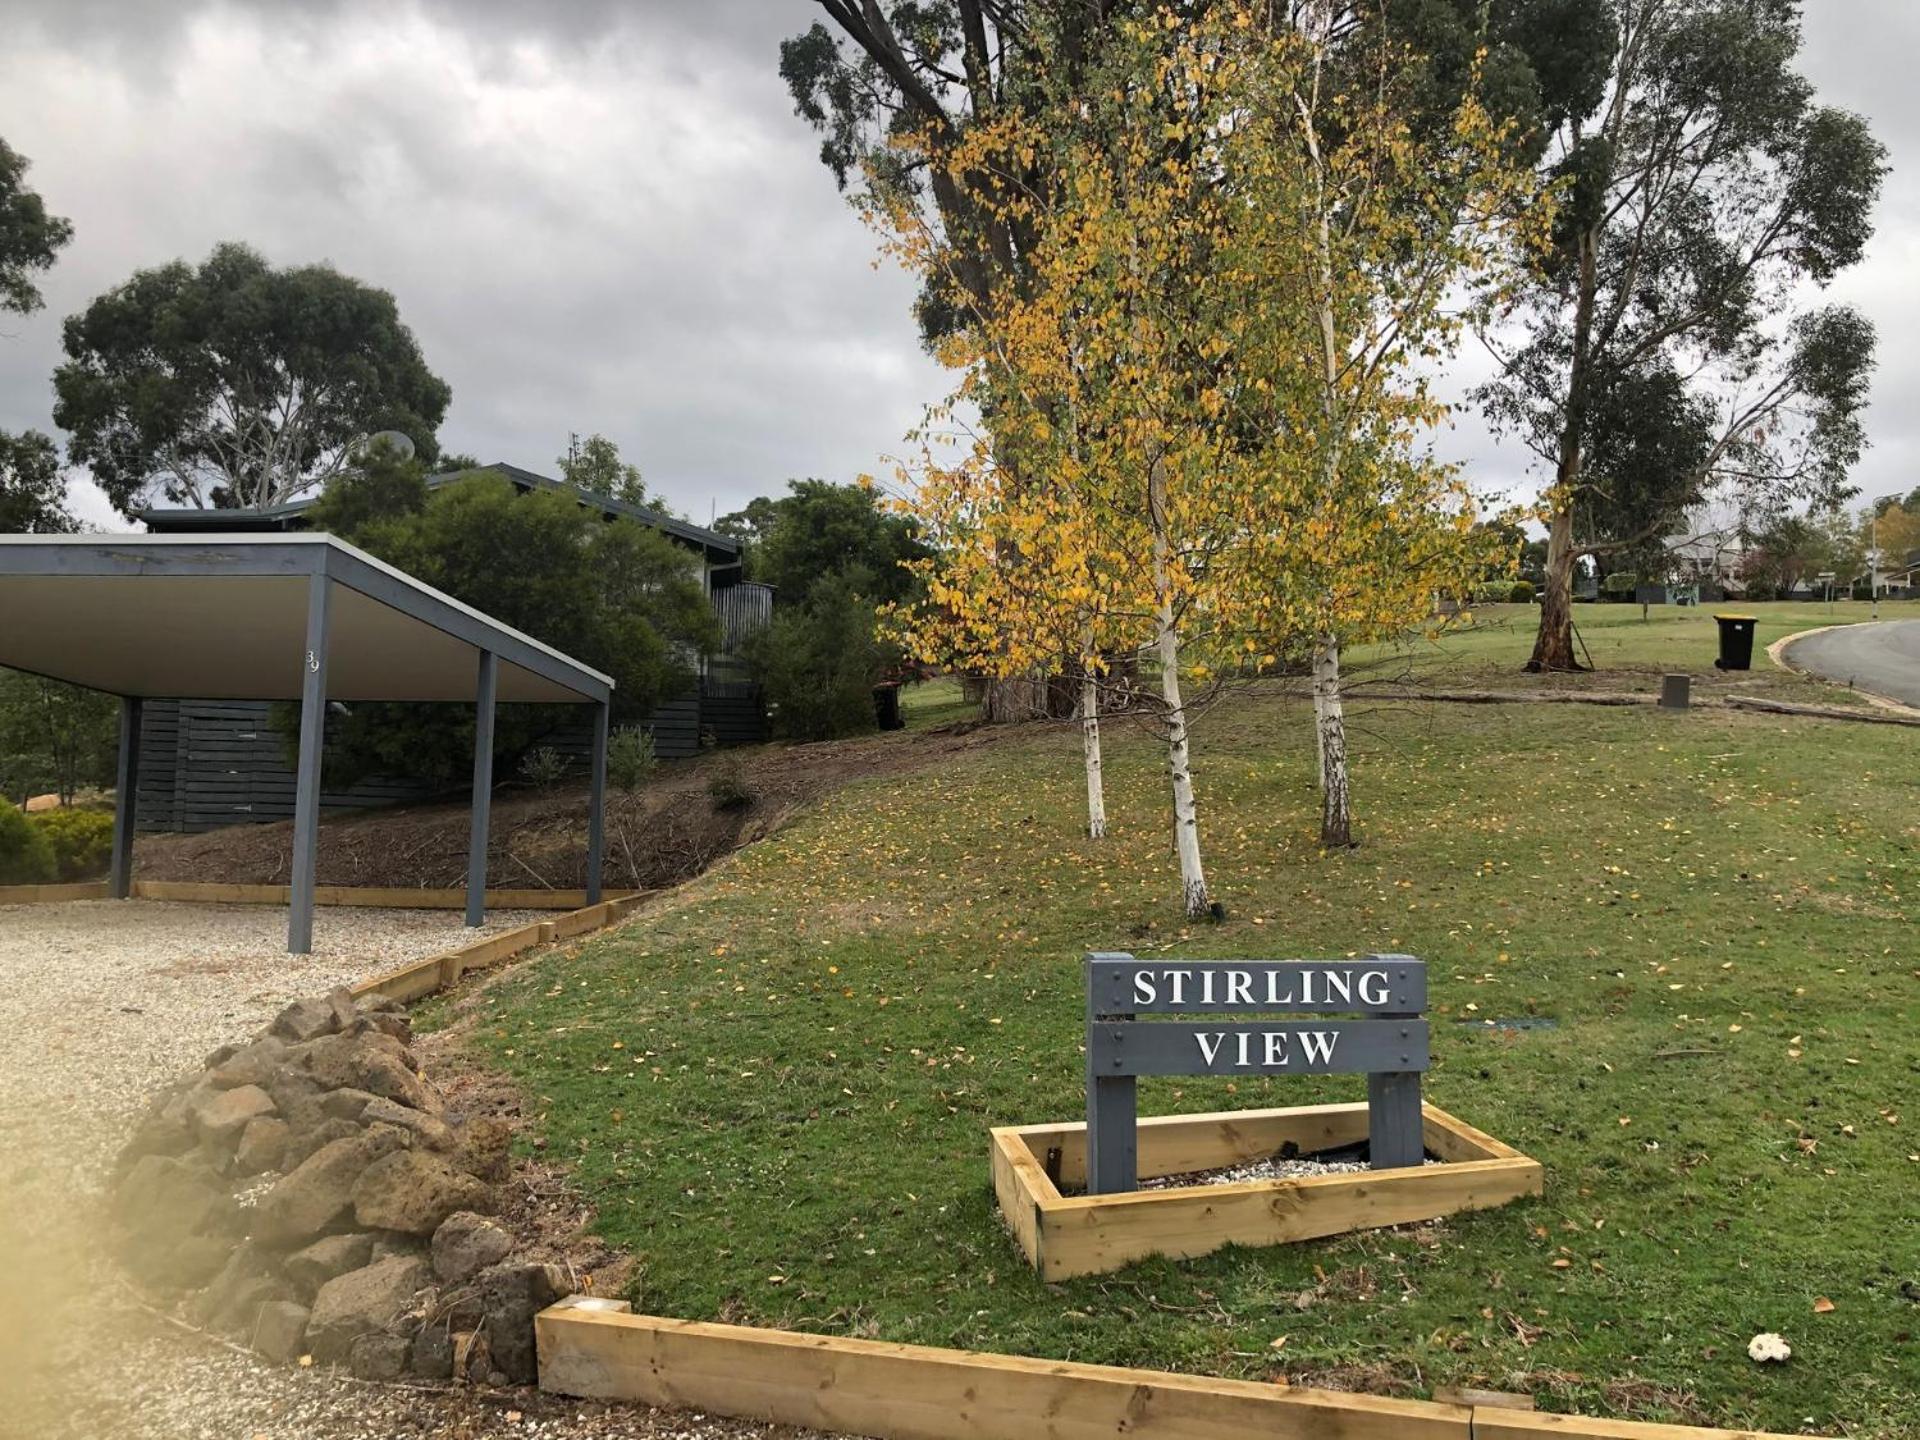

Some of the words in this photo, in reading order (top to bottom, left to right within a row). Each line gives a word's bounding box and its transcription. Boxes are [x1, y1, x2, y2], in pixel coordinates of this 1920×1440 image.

[306, 650, 320, 673] 39
[1133, 970, 1391, 1005] STIRLING
[1194, 1031, 1340, 1067] VIEW
